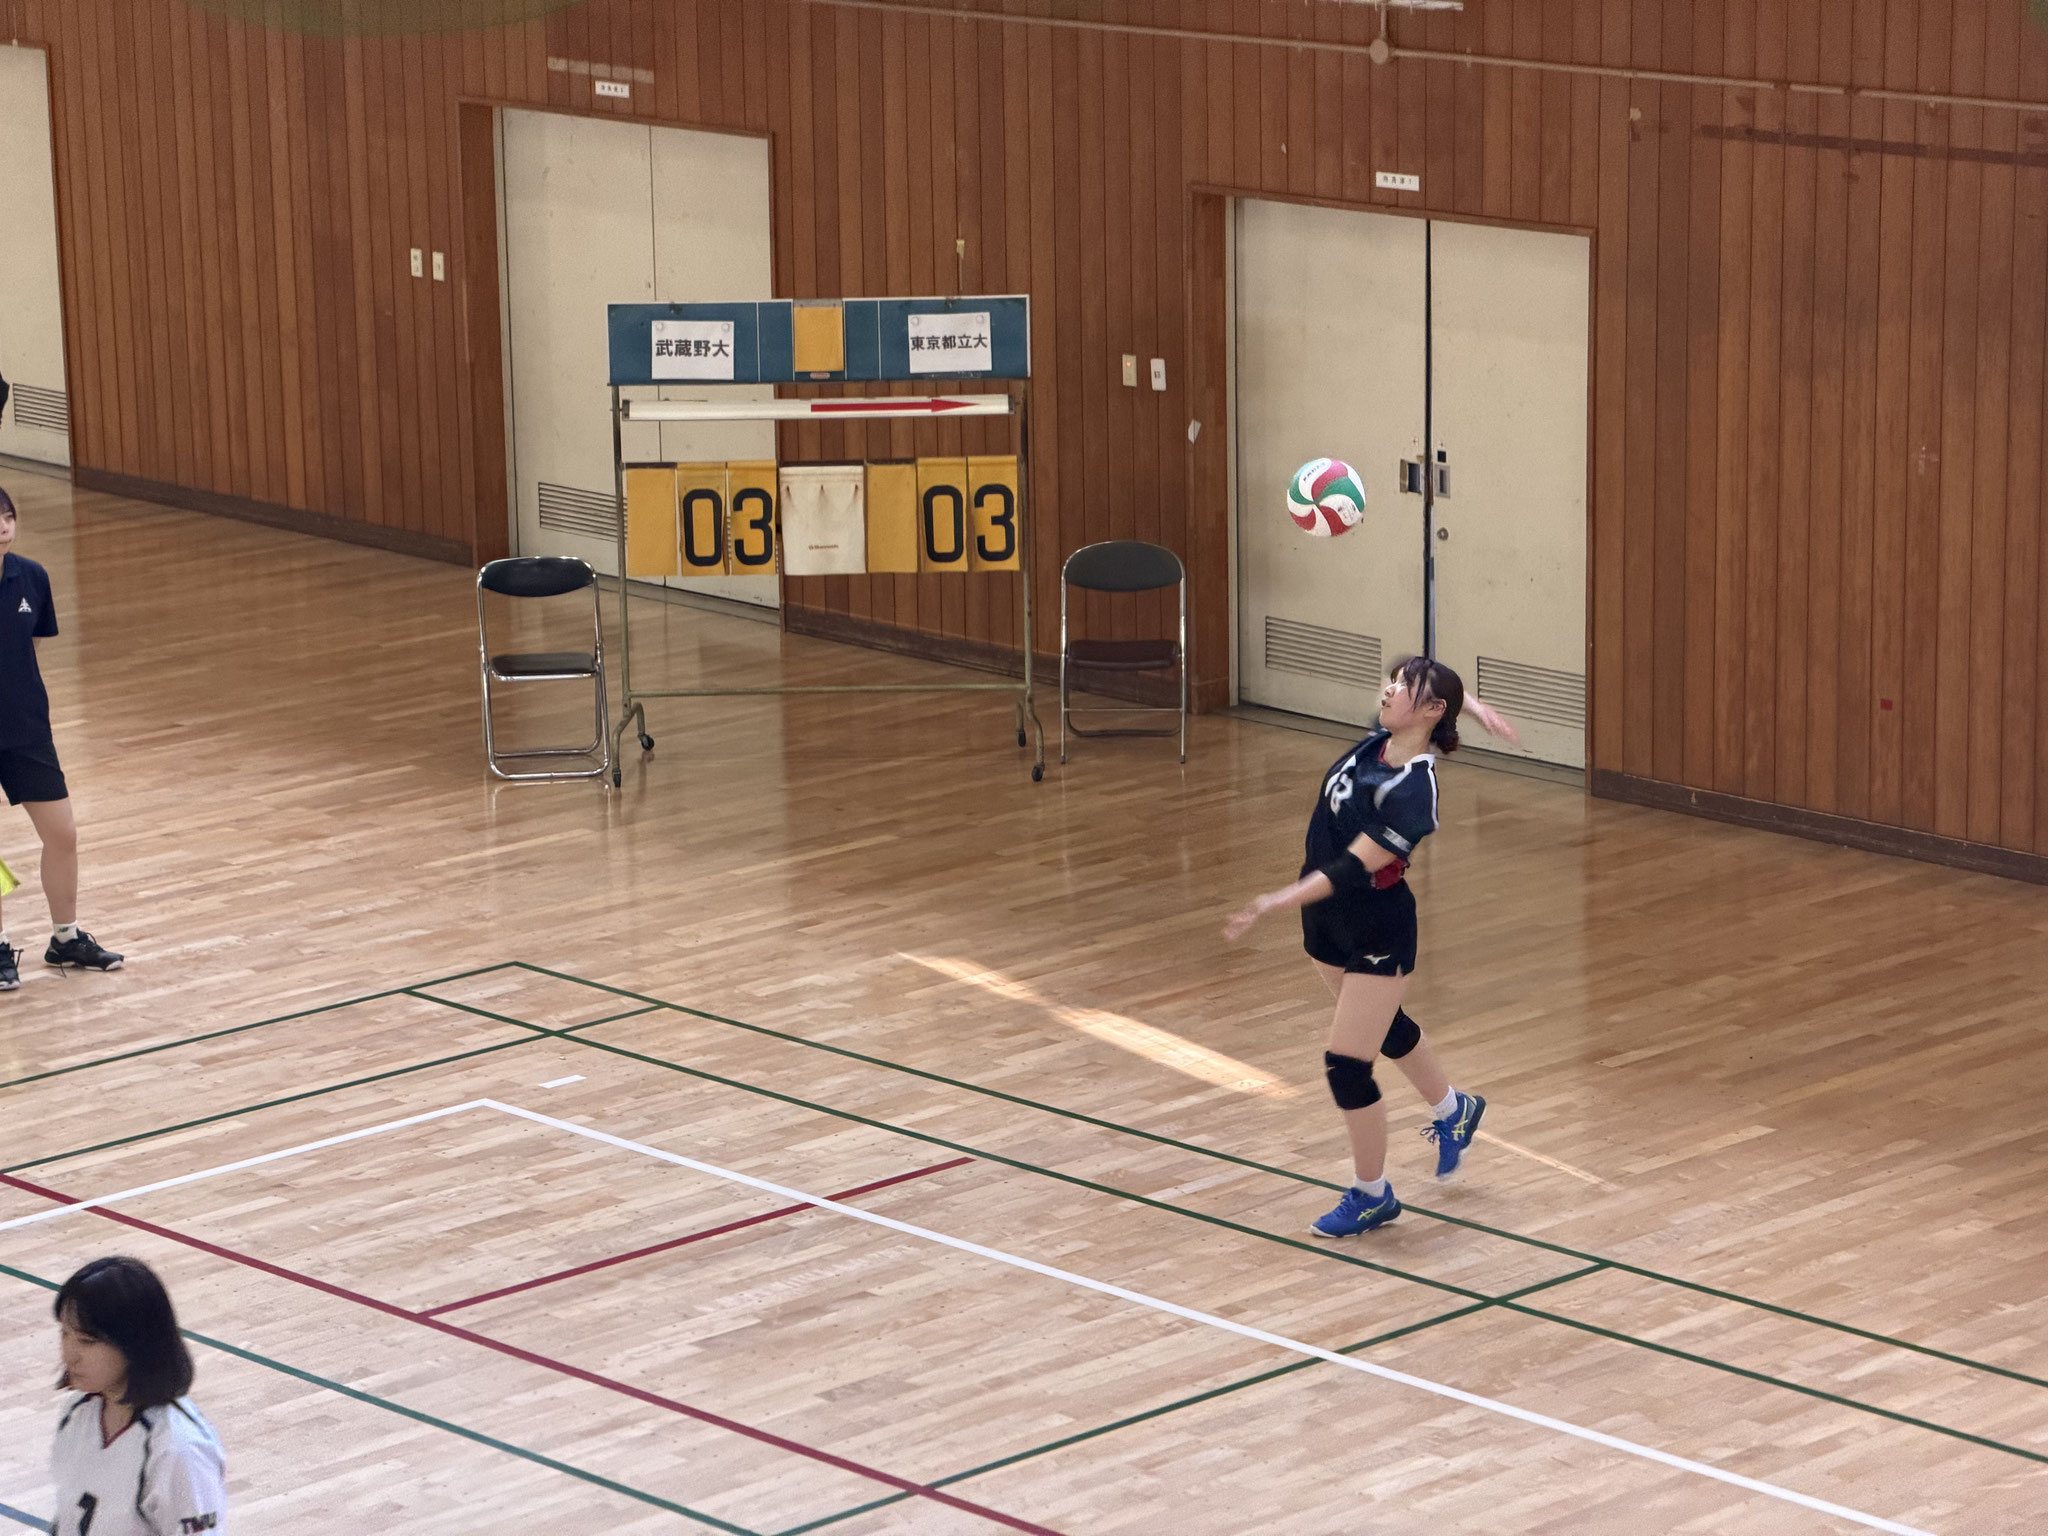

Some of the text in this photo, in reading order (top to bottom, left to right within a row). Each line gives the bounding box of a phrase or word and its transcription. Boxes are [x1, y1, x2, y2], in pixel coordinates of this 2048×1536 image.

[655, 339, 730, 358] 武蔵野大
[910, 332, 988, 352] 東京都立大
[682, 487, 773, 567] 03
[922, 483, 1015, 563] 03
